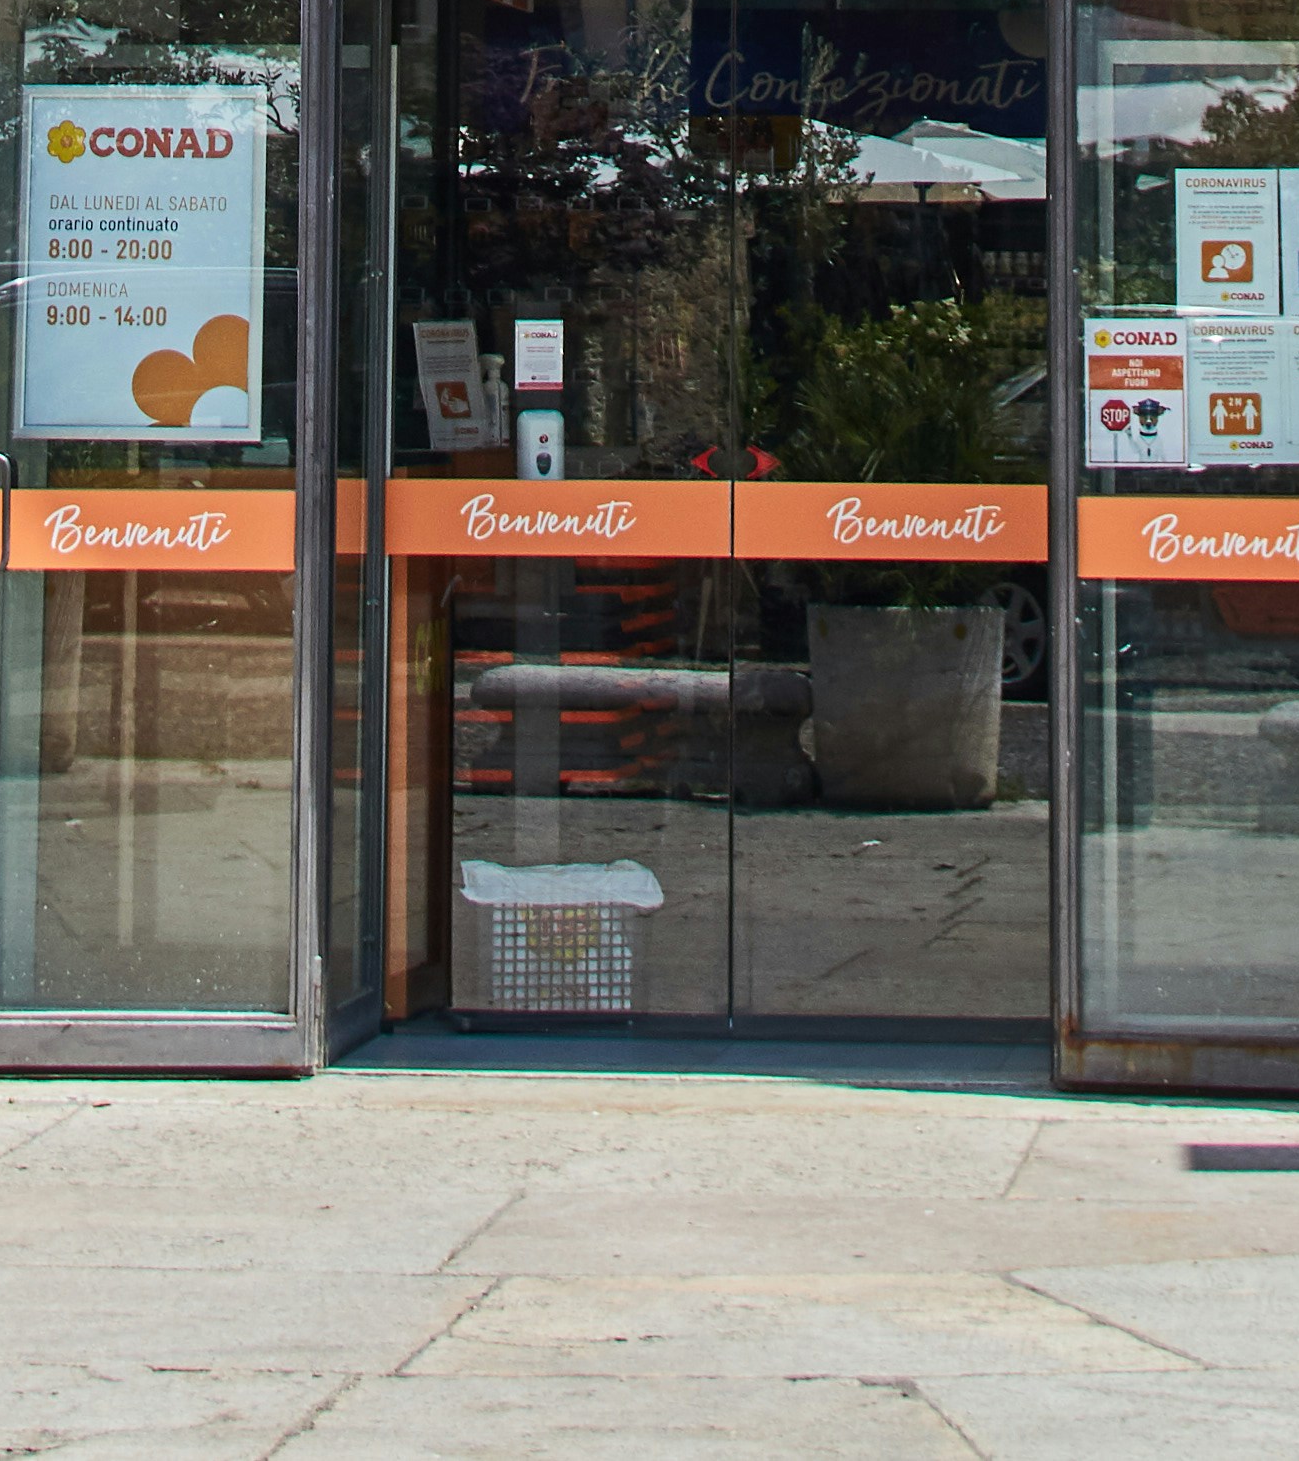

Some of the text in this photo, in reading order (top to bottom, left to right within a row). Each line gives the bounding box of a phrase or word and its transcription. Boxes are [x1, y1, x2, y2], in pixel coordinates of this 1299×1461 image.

[89, 127, 234, 158] CONAD
[1185, 178, 1267, 188] CORONAVIRUS
[50, 194, 228, 212] DAL LUNEDI AL SABATO
[48, 217, 179, 232] orario continuato
[48, 238, 93, 259] 8:00
[115, 239, 173, 260] 20:00
[47, 281, 129, 298] DOMENICA
[1230, 292, 1265, 301] CONAD
[46, 304, 91, 326] 9:00
[114, 306, 167, 326] 14:00
[1113, 331, 1178, 345] CONAD
[1193, 325, 1275, 336] CORONAVIRUS
[1128, 358, 1144, 367] NOI
[1102, 409, 1130, 423] STOP
[1238, 440, 1274, 449] CONAD
[460, 493, 638, 540] Benvenuti
[826, 497, 1007, 544] Benvenuti
[43, 504, 232, 553] Benvenuti
